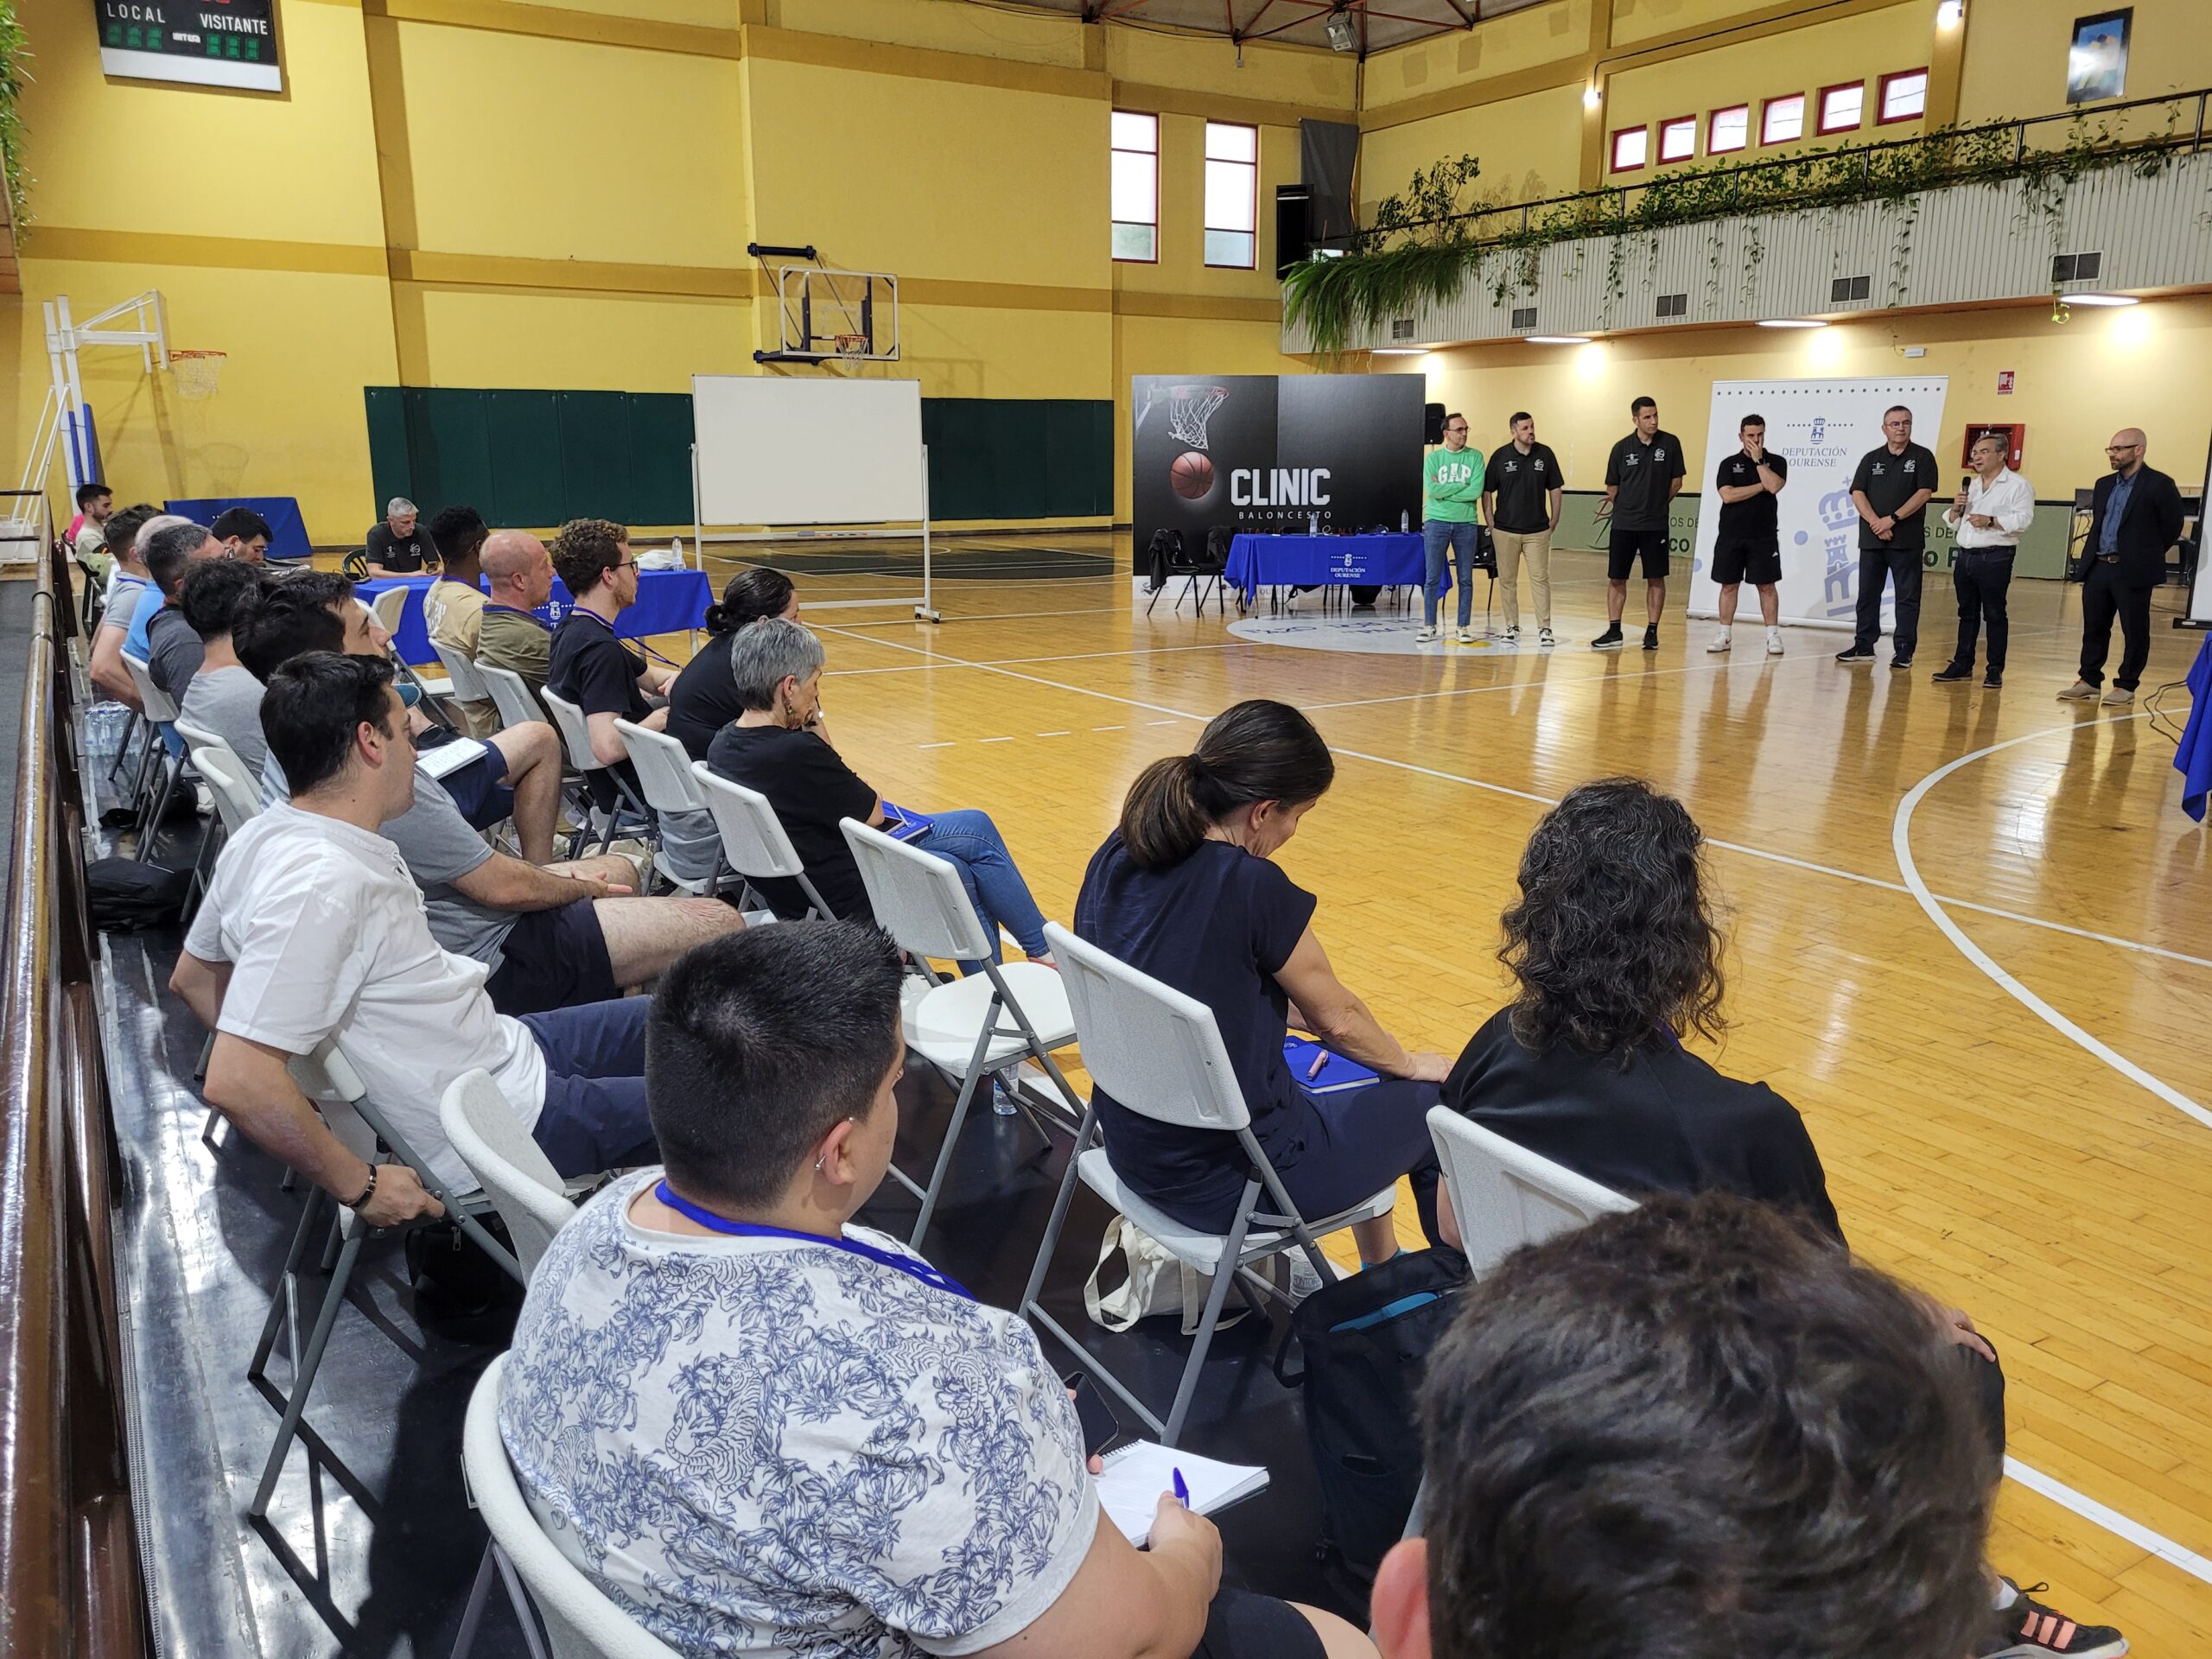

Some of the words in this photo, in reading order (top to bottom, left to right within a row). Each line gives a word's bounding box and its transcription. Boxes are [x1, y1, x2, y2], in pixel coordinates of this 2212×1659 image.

[106, 3, 166, 23] LOCAL
[200, 13, 269, 35] VISITANTE
[1782, 446, 1847, 457] DEPUTACIÓN
[1789, 458, 1837, 467] OURENSE
[1438, 462, 1471, 485] GAP
[1230, 468, 1331, 506] CLINIC
[1238, 511, 1332, 519] BALONCESTO
